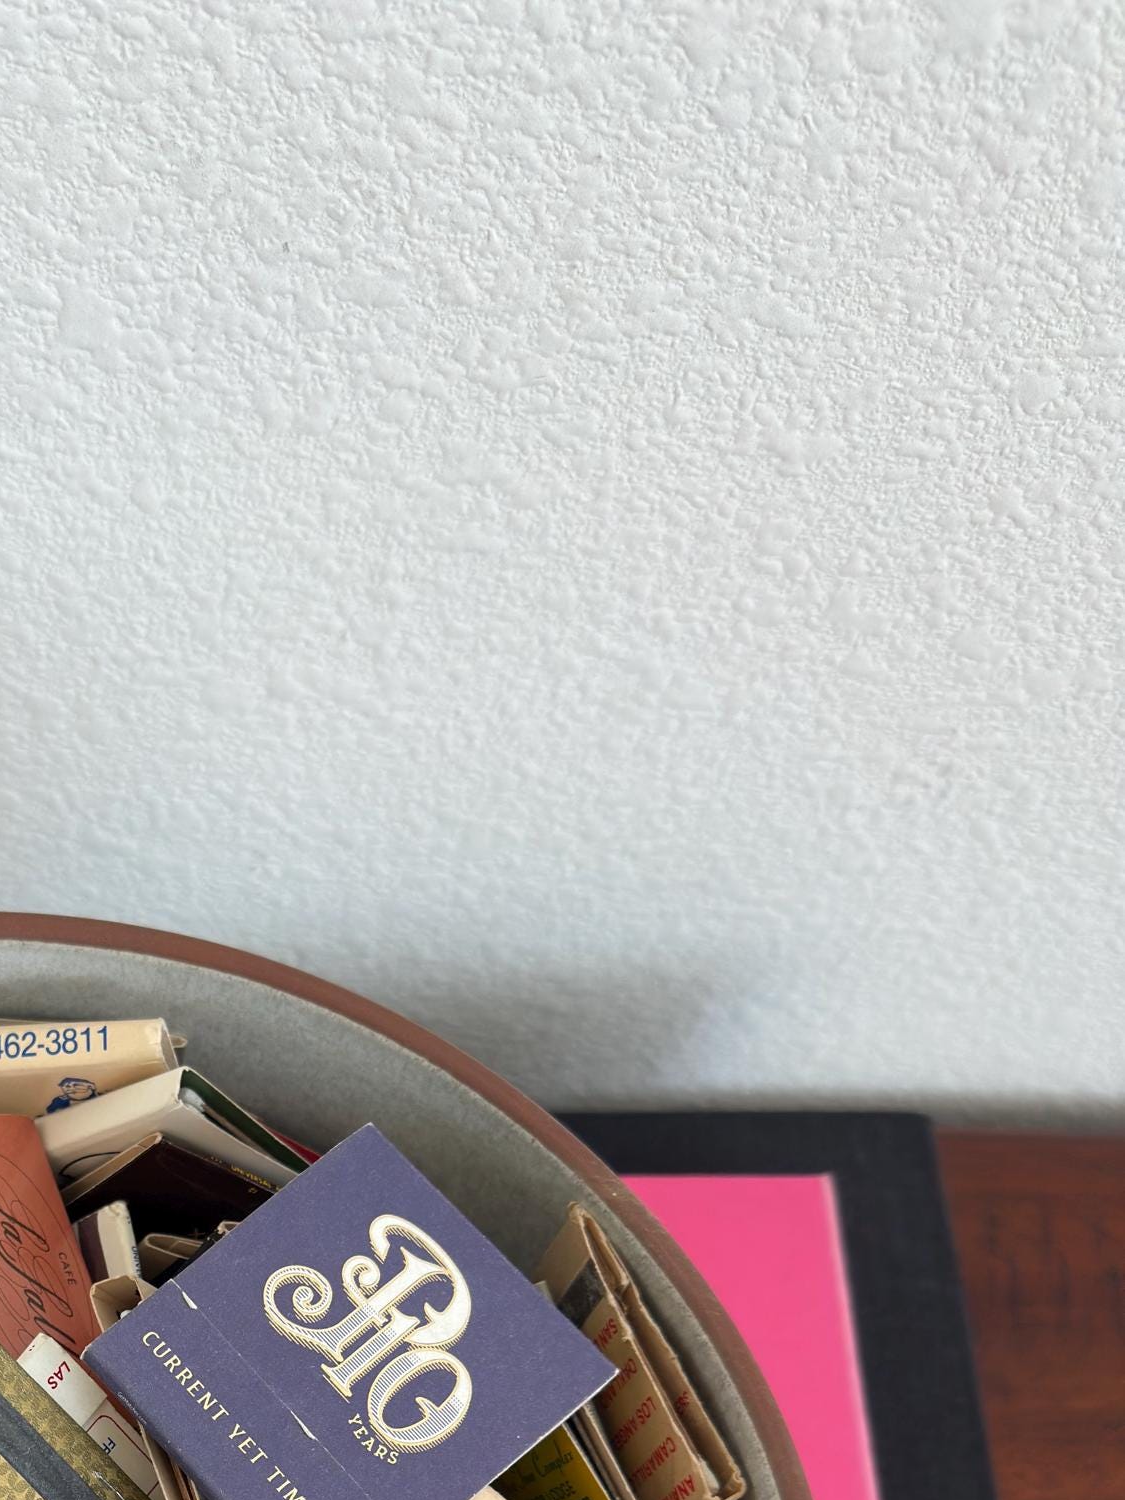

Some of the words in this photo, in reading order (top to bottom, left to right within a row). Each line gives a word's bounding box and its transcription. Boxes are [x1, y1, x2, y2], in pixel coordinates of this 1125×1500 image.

[47, 1361, 72, 1391] LAS
[142, 1331, 230, 1422] CURRENT
[228, 1423, 269, 1465] YET
[348, 1413, 400, 1466] YEARS
